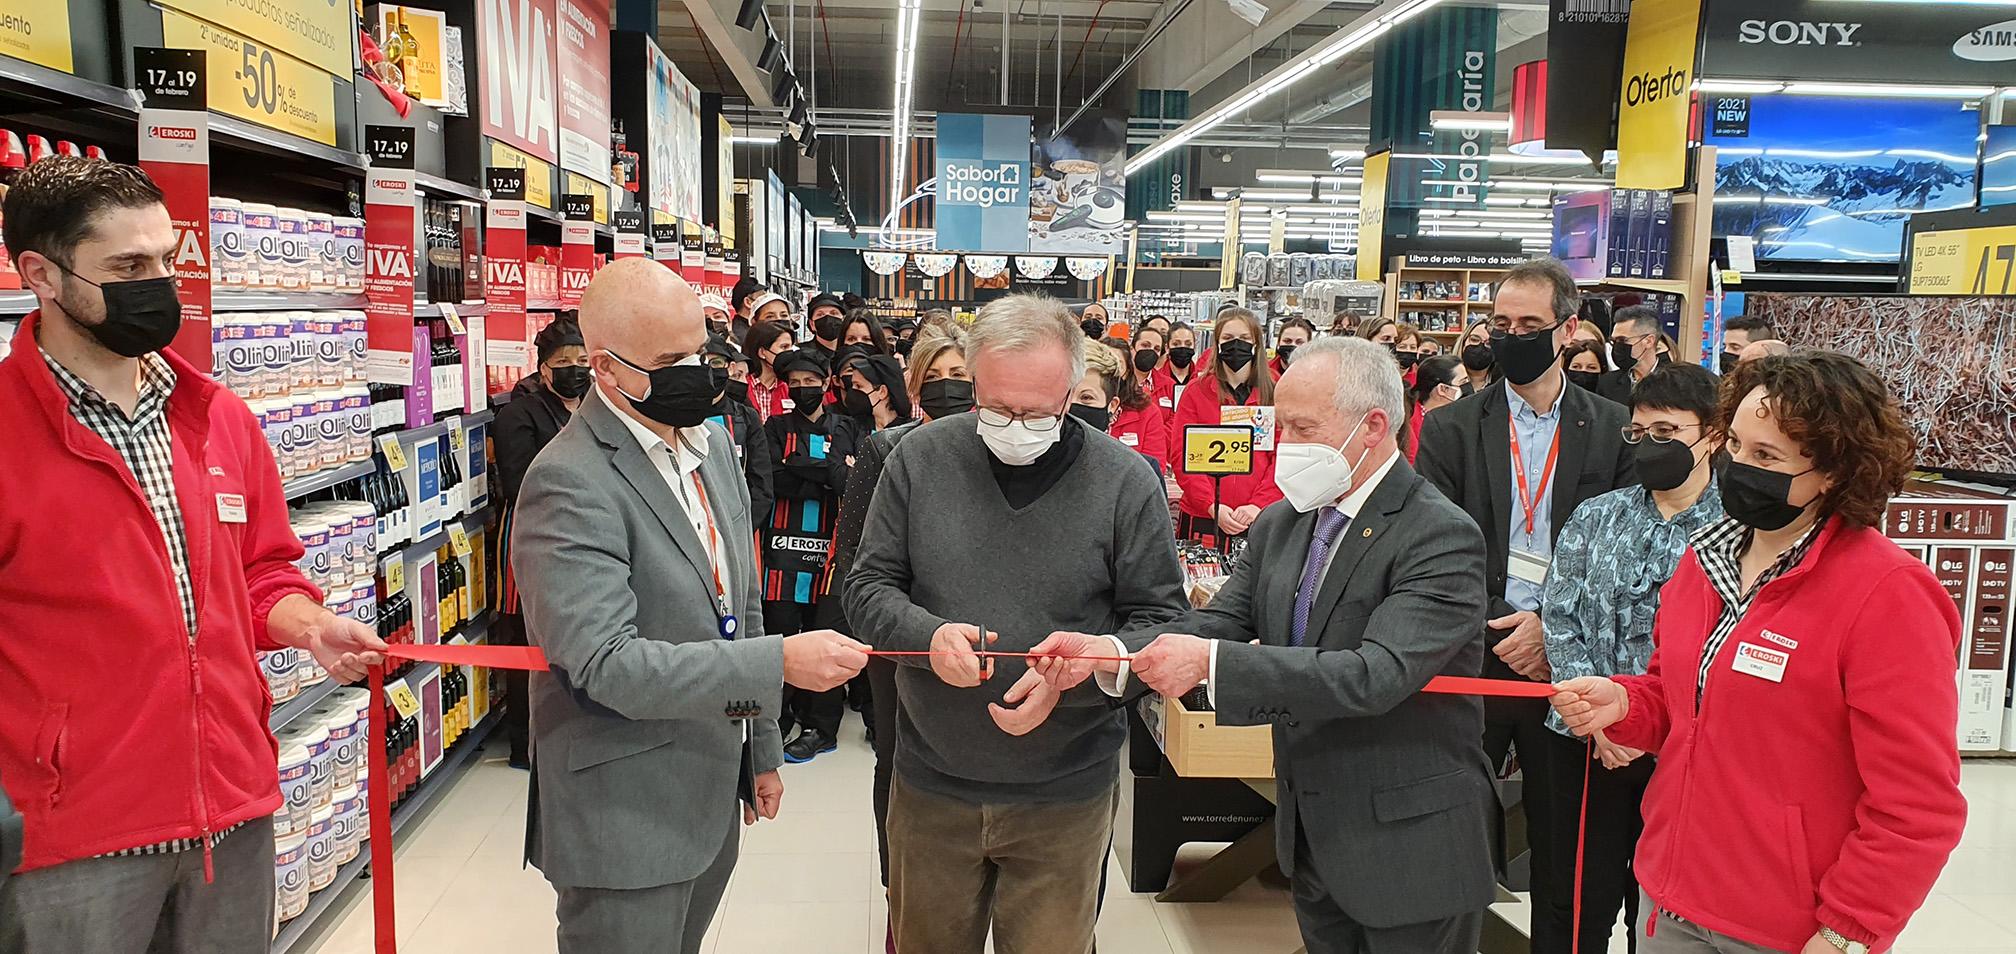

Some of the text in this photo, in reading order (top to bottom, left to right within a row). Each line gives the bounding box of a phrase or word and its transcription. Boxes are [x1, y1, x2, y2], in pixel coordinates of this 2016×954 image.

[1739, 20, 1861, 46] SONY
[211, 31, 239, 52] unidad
[147, 69, 166, 86] 17
[177, 70, 197, 87] 19
[1626, 66, 1686, 107] Oferta
[1718, 98, 1746, 110] 2021
[289, 104, 318, 123] descuento
[1717, 110, 1747, 121] NEW
[161, 128, 195, 138] EROSKI
[373, 140, 387, 152] 17
[394, 141, 408, 153] 19
[946, 164, 1000, 182] Sabor
[492, 178, 504, 188] 17
[509, 179, 520, 188] 19
[946, 181, 1019, 208] Hogar
[567, 203, 590, 212] 17 19
[1915, 247, 1924, 257] TV
[1924, 246, 1936, 257] LED
[1409, 254, 1428, 263] Libro
[1430, 255, 1441, 263] de
[1467, 256, 1486, 264] Libro
[1488, 256, 1498, 264] de
[1208, 440, 1250, 464] 2,95
[1901, 510, 1909, 522] LG
[1952, 561, 1963, 569] LG
[1995, 562, 2007, 570] LG
[1772, 635, 1796, 647] EROSKI
[1752, 650, 1783, 665] EROSKI
